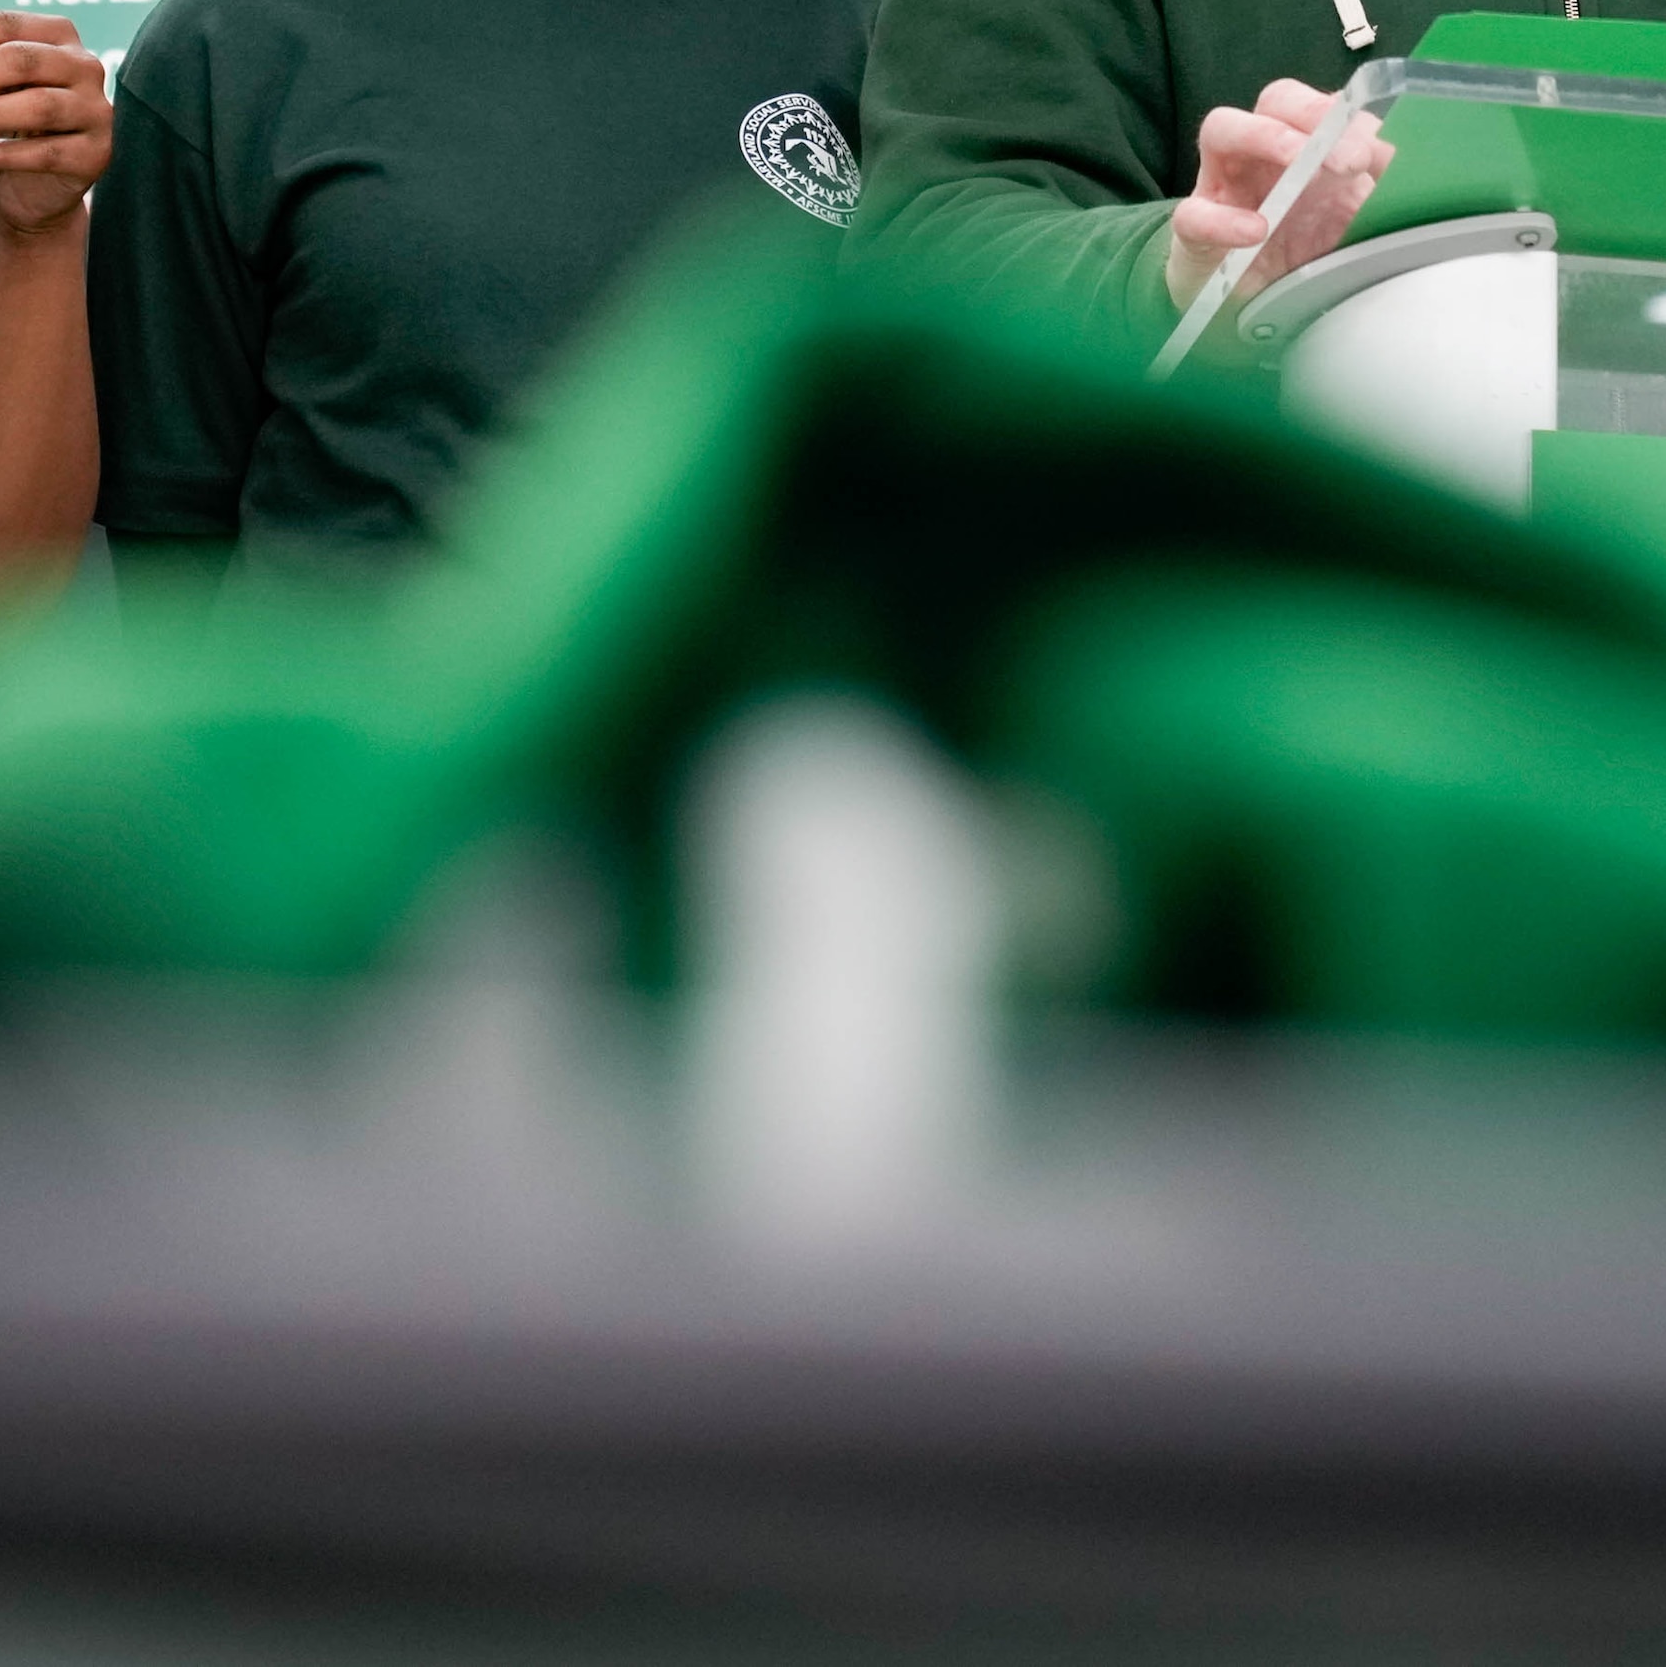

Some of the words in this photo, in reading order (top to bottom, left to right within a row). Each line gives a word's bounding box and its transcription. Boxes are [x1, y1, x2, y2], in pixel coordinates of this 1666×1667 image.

[746, 105, 779, 133] SOCIAL
[803, 127, 827, 149] 112
[744, 133, 786, 188] MARYLAND
[796, 196, 843, 223] AFSCME
